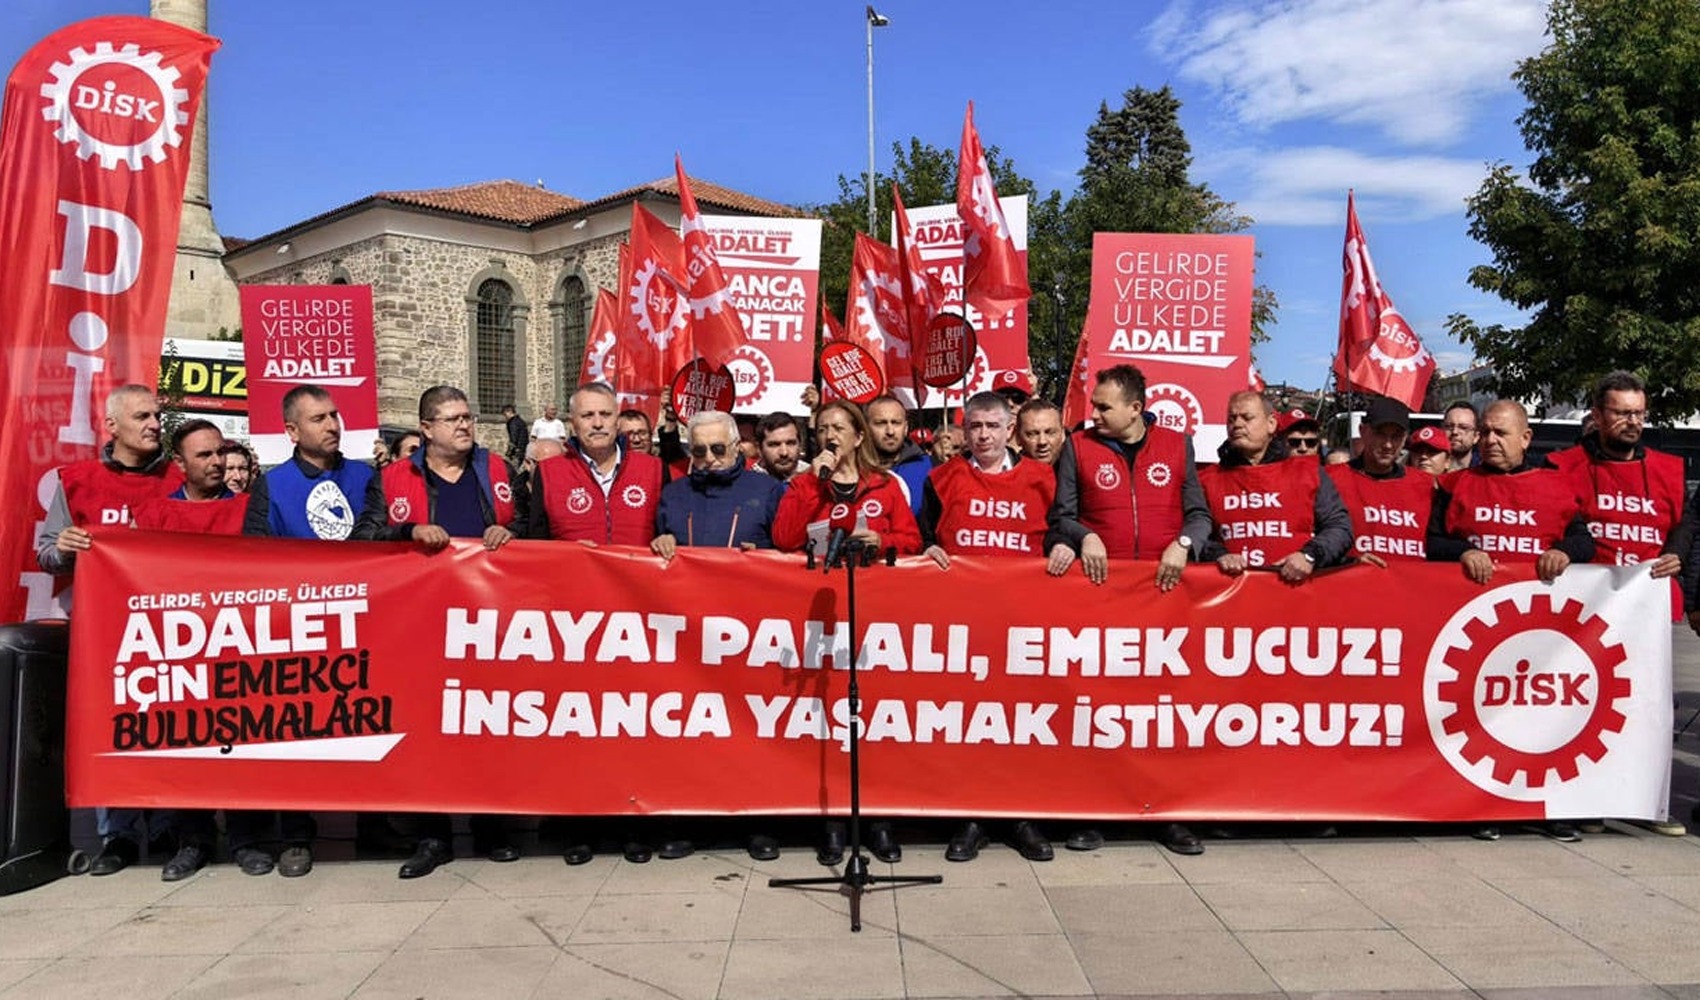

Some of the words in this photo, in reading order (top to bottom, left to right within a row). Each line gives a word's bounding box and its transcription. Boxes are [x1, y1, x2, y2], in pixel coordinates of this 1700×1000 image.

[75, 80, 160, 123] DİSK
[1113, 298, 1227, 328] ÜLKEDE
[264, 335, 356, 357] ÜLKEDE
[1108, 328, 1226, 354] ADALET
[263, 358, 356, 378] ADALET
[968, 497, 1027, 520] DİSK
[1223, 490, 1282, 511] DİSK
[1597, 491, 1658, 516] DİSK
[1364, 505, 1419, 529] DİSK
[1475, 503, 1537, 526] DİSK
[956, 527, 1031, 551] GENEL
[1220, 520, 1293, 541] GENEL
[1586, 522, 1663, 545] GENEL
[1355, 535, 1427, 558] GENEL
[1467, 534, 1545, 555] GENEL
[297, 583, 368, 600] ÜLKEDE
[116, 599, 369, 663] ADALET
[444, 608, 688, 663] HAYAT
[702, 615, 990, 681] PAHALI,
[1005, 626, 1192, 677] EMEK
[1204, 627, 1404, 678] UCUZ!
[1482, 658, 1592, 708] DİSK
[113, 695, 393, 755] BULUŞMALARI
[441, 679, 732, 738] İNSANCA
[744, 694, 1060, 753] YAŞAMAK
[1071, 694, 1405, 749] İSTİYORUZ!
